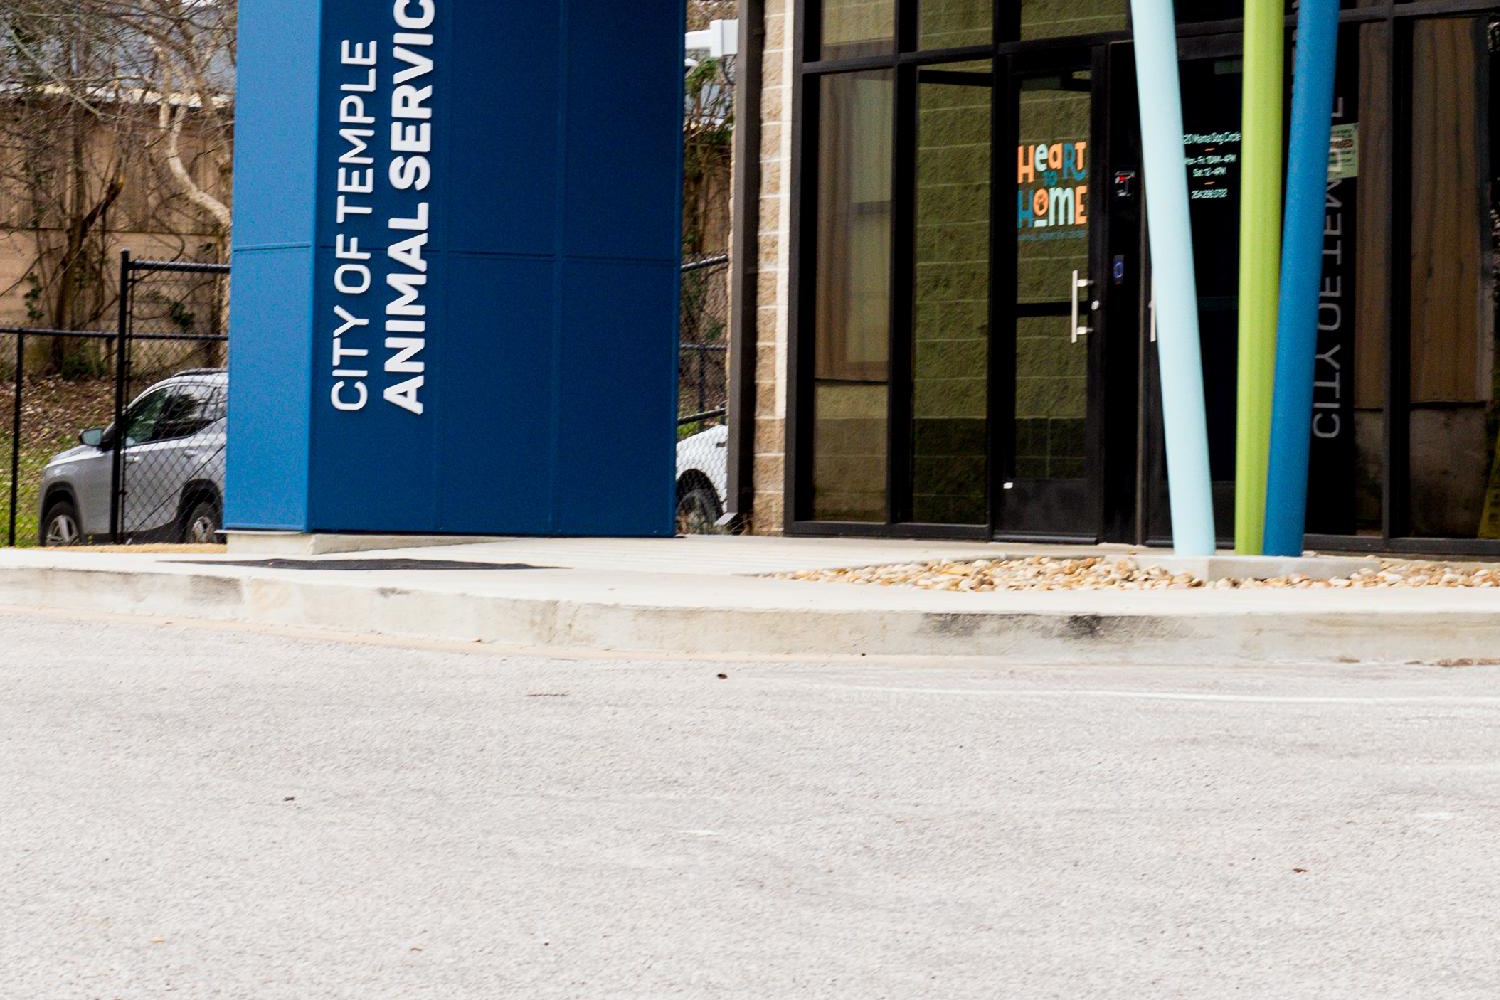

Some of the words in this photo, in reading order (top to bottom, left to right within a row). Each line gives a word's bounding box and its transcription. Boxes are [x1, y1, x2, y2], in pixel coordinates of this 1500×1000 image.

[336, 38, 378, 224] TEMPLE
[333, 233, 372, 294] OF
[382, 201, 430, 415] ANIMAL
[330, 303, 370, 412] CITY
